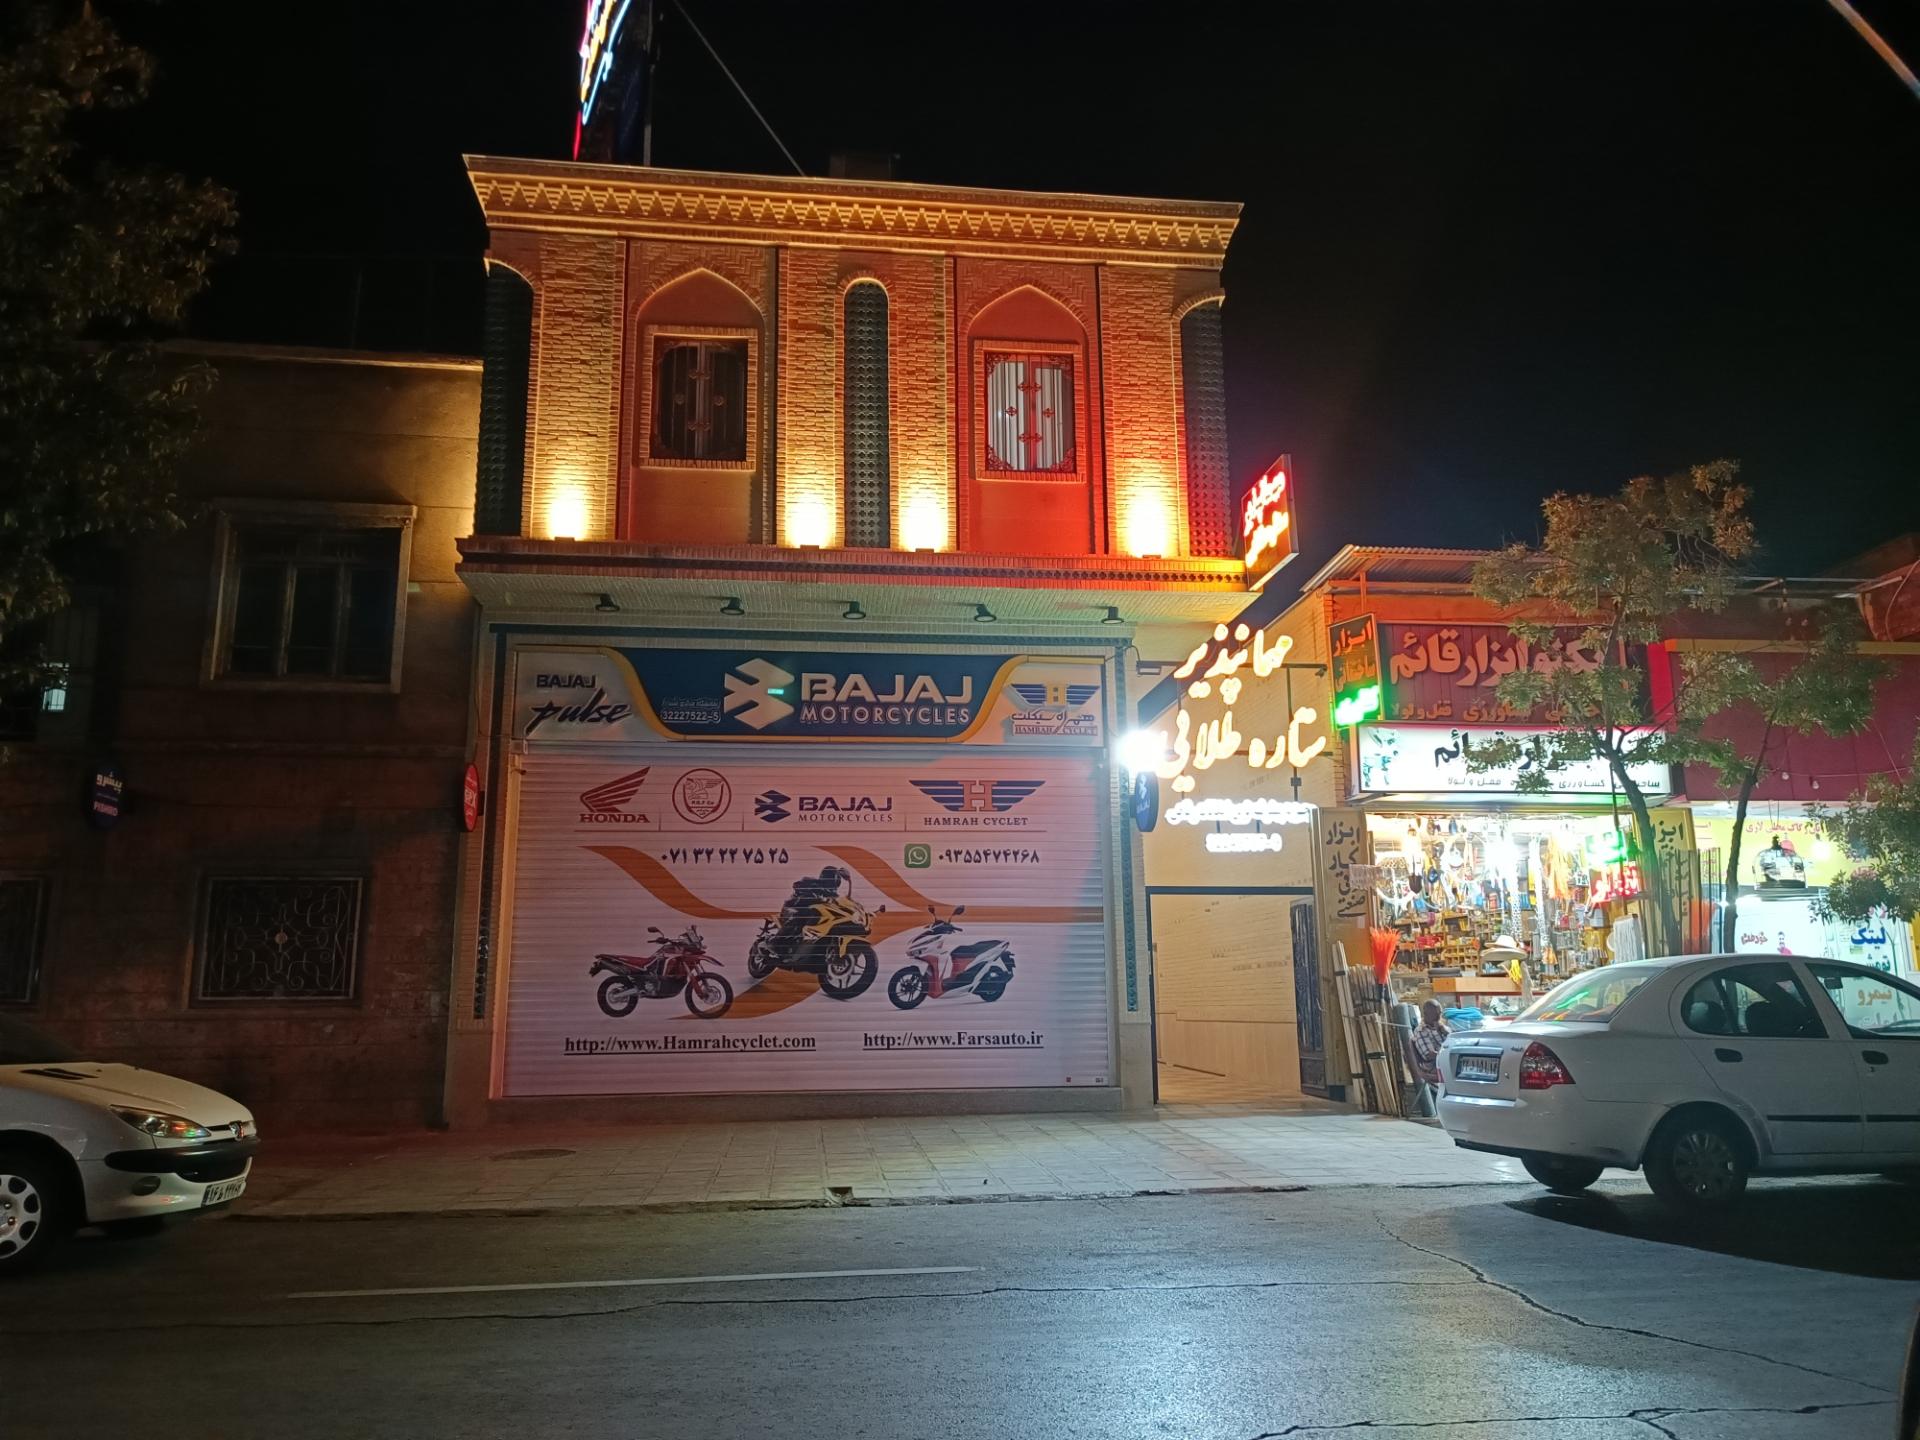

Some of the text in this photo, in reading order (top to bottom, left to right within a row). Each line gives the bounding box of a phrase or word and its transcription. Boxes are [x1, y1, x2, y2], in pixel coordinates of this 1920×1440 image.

[1333, 620, 1372, 656] ابزار
[1389, 628, 1461, 685] قائم
[536, 674, 597, 689] BAJAJ
[801, 671, 973, 703] BAJAJ
[801, 703, 970, 725] MOTORCYCLES
[1014, 725, 1098, 736] HAMRAH CYCLET
[798, 796, 892, 812] BAJAJ
[579, 813, 650, 824] HONDA
[798, 813, 894, 823] MOTORCYCLES
[923, 817, 1029, 826] HAMRAH CYCLET
[1326, 820, 1360, 846] ابزار
[564, 1034, 816, 1054] http://www.Hamrahcyclet.com
[863, 1031, 1044, 1050] http://www.Farsauto.ir
